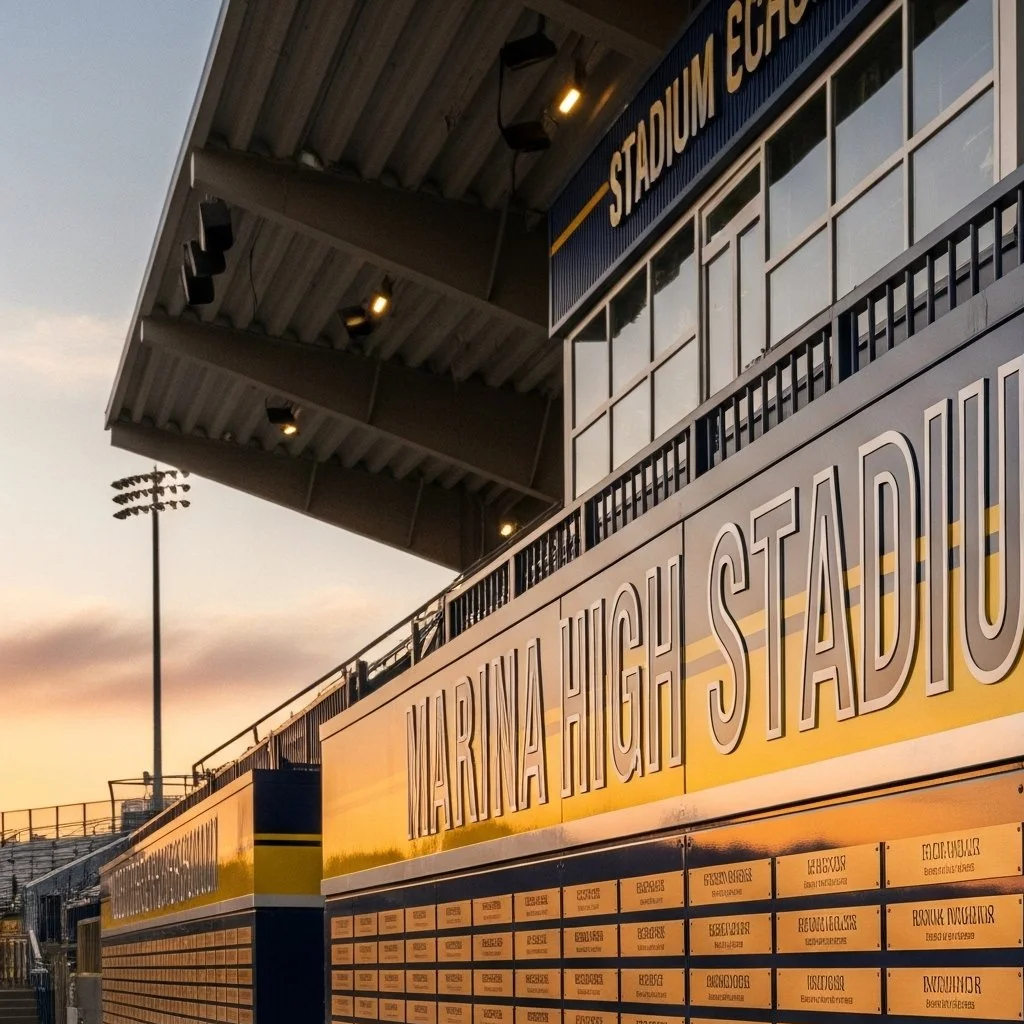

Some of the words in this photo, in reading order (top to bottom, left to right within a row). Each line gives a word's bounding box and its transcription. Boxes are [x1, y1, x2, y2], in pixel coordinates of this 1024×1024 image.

[609, 33, 716, 228] STADIUM
[407, 638, 549, 841] MARINA
[560, 554, 684, 799] HIGH
